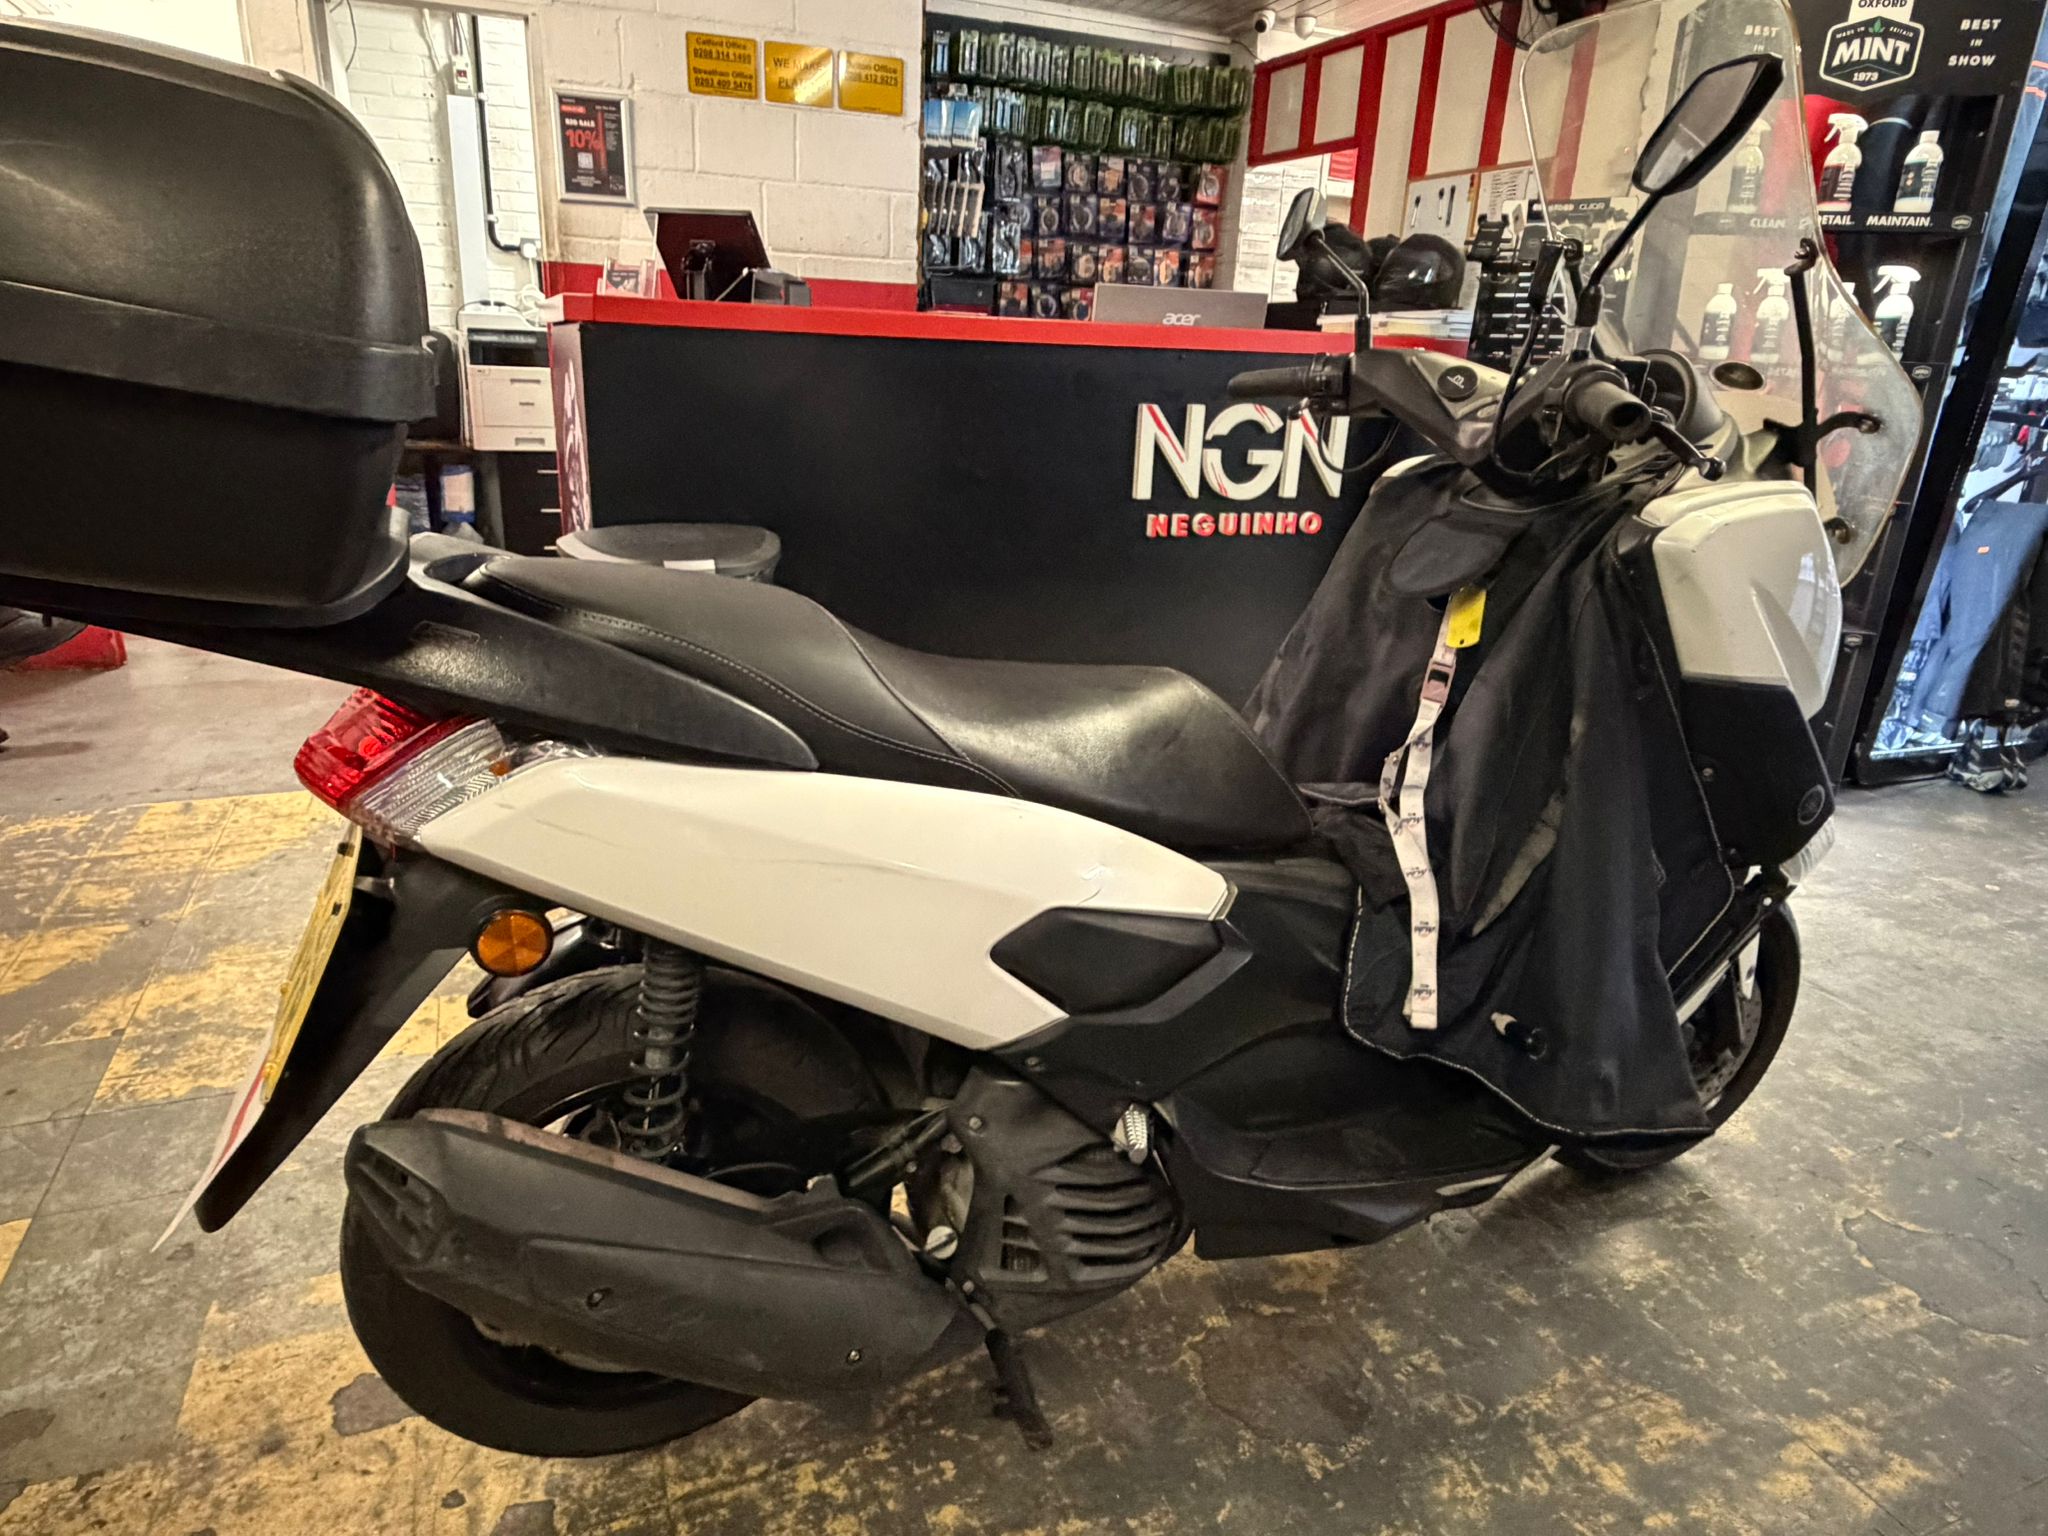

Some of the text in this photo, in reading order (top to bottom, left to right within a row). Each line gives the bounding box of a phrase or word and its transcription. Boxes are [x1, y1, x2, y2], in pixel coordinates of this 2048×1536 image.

[1858, 0, 1907, 8] OXFORD
[1744, 24, 1780, 37] BEST
[1960, 18, 2002, 31] BEST
[1970, 38, 1983, 47] IN
[1831, 36, 1911, 68] MINT
[772, 57, 790, 69] WE
[1948, 54, 1996, 67] SHOW
[873, 63, 898, 74] Office
[1852, 71, 1879, 82] 1973
[565, 129, 601, 150] 10%
[1162, 312, 1201, 326] acer
[1132, 402, 1350, 500] NGN
[1146, 510, 1323, 538] NEGUINHO
